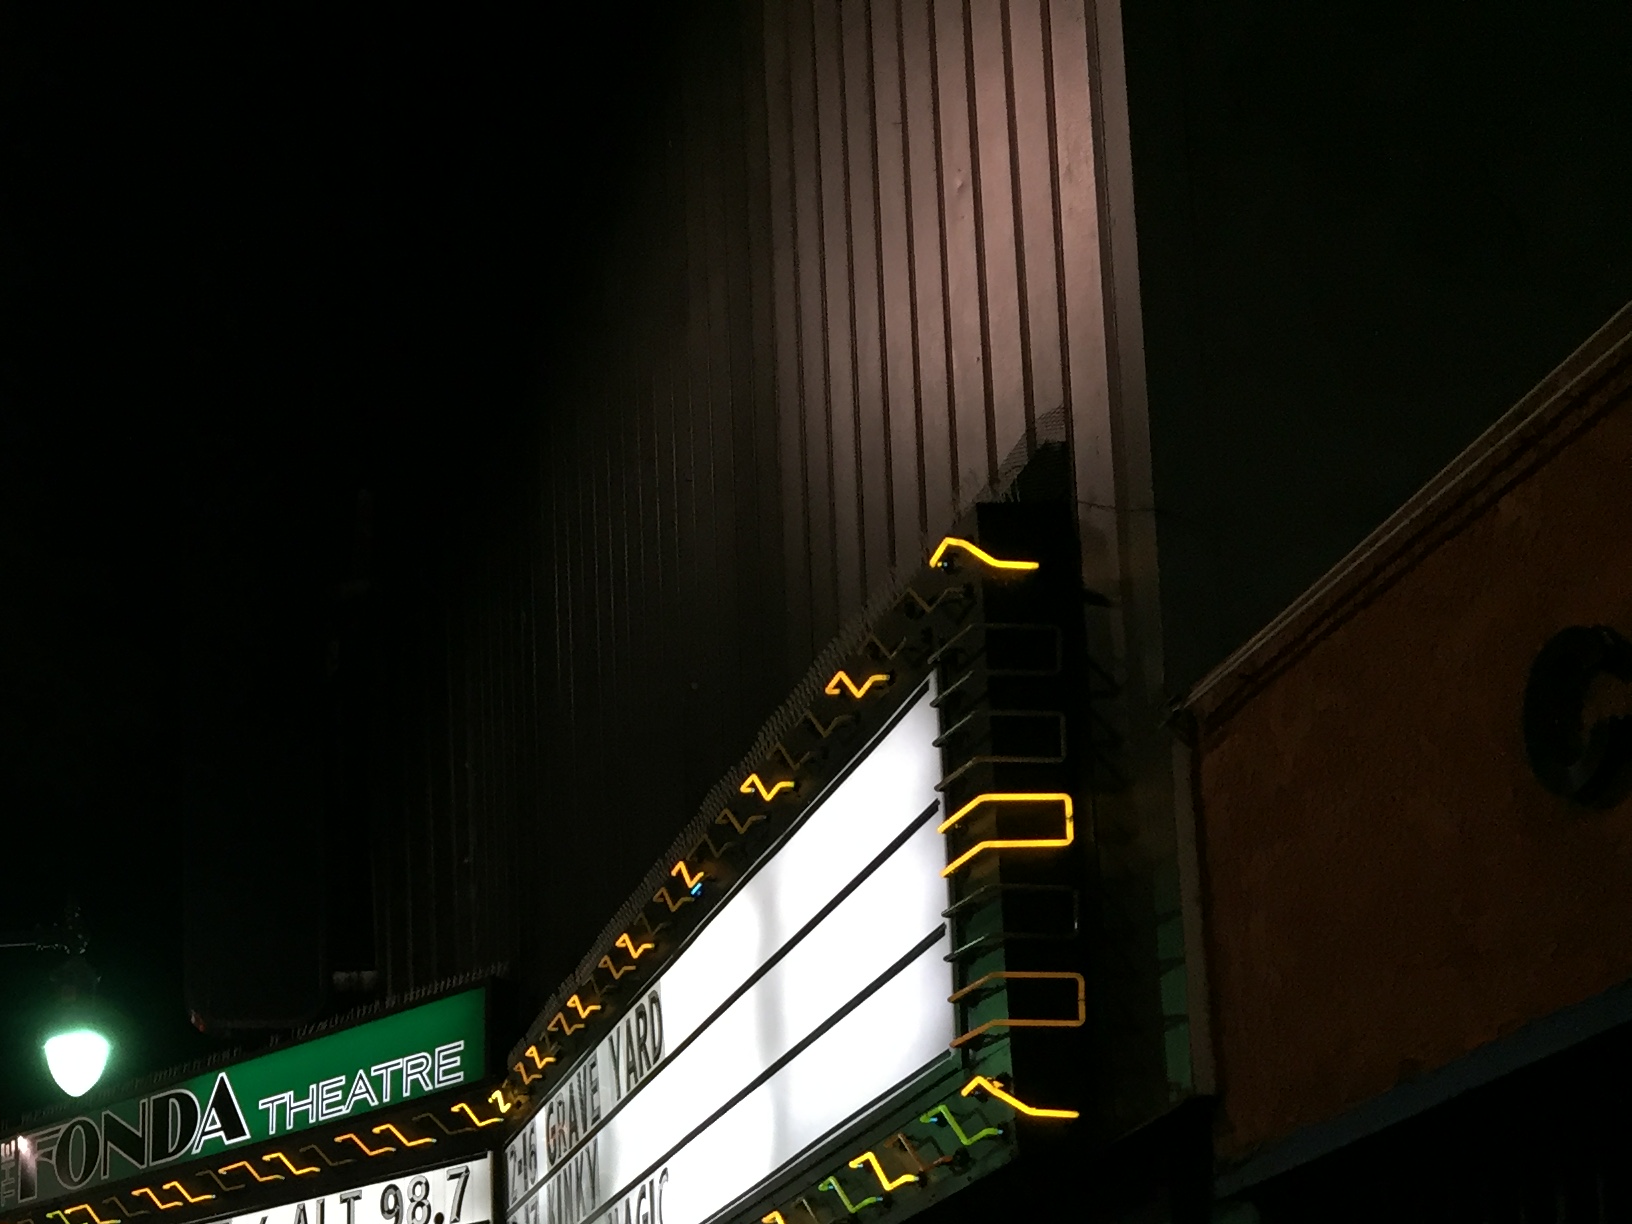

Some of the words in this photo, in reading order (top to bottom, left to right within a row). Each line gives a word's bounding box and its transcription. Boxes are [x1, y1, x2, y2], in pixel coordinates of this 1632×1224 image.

[17, 1071, 252, 1205] FONDA
[259, 1040, 466, 1136] THEATRE
[545, 1060, 602, 1167] GRAVE
[608, 989, 665, 1103] YARD
